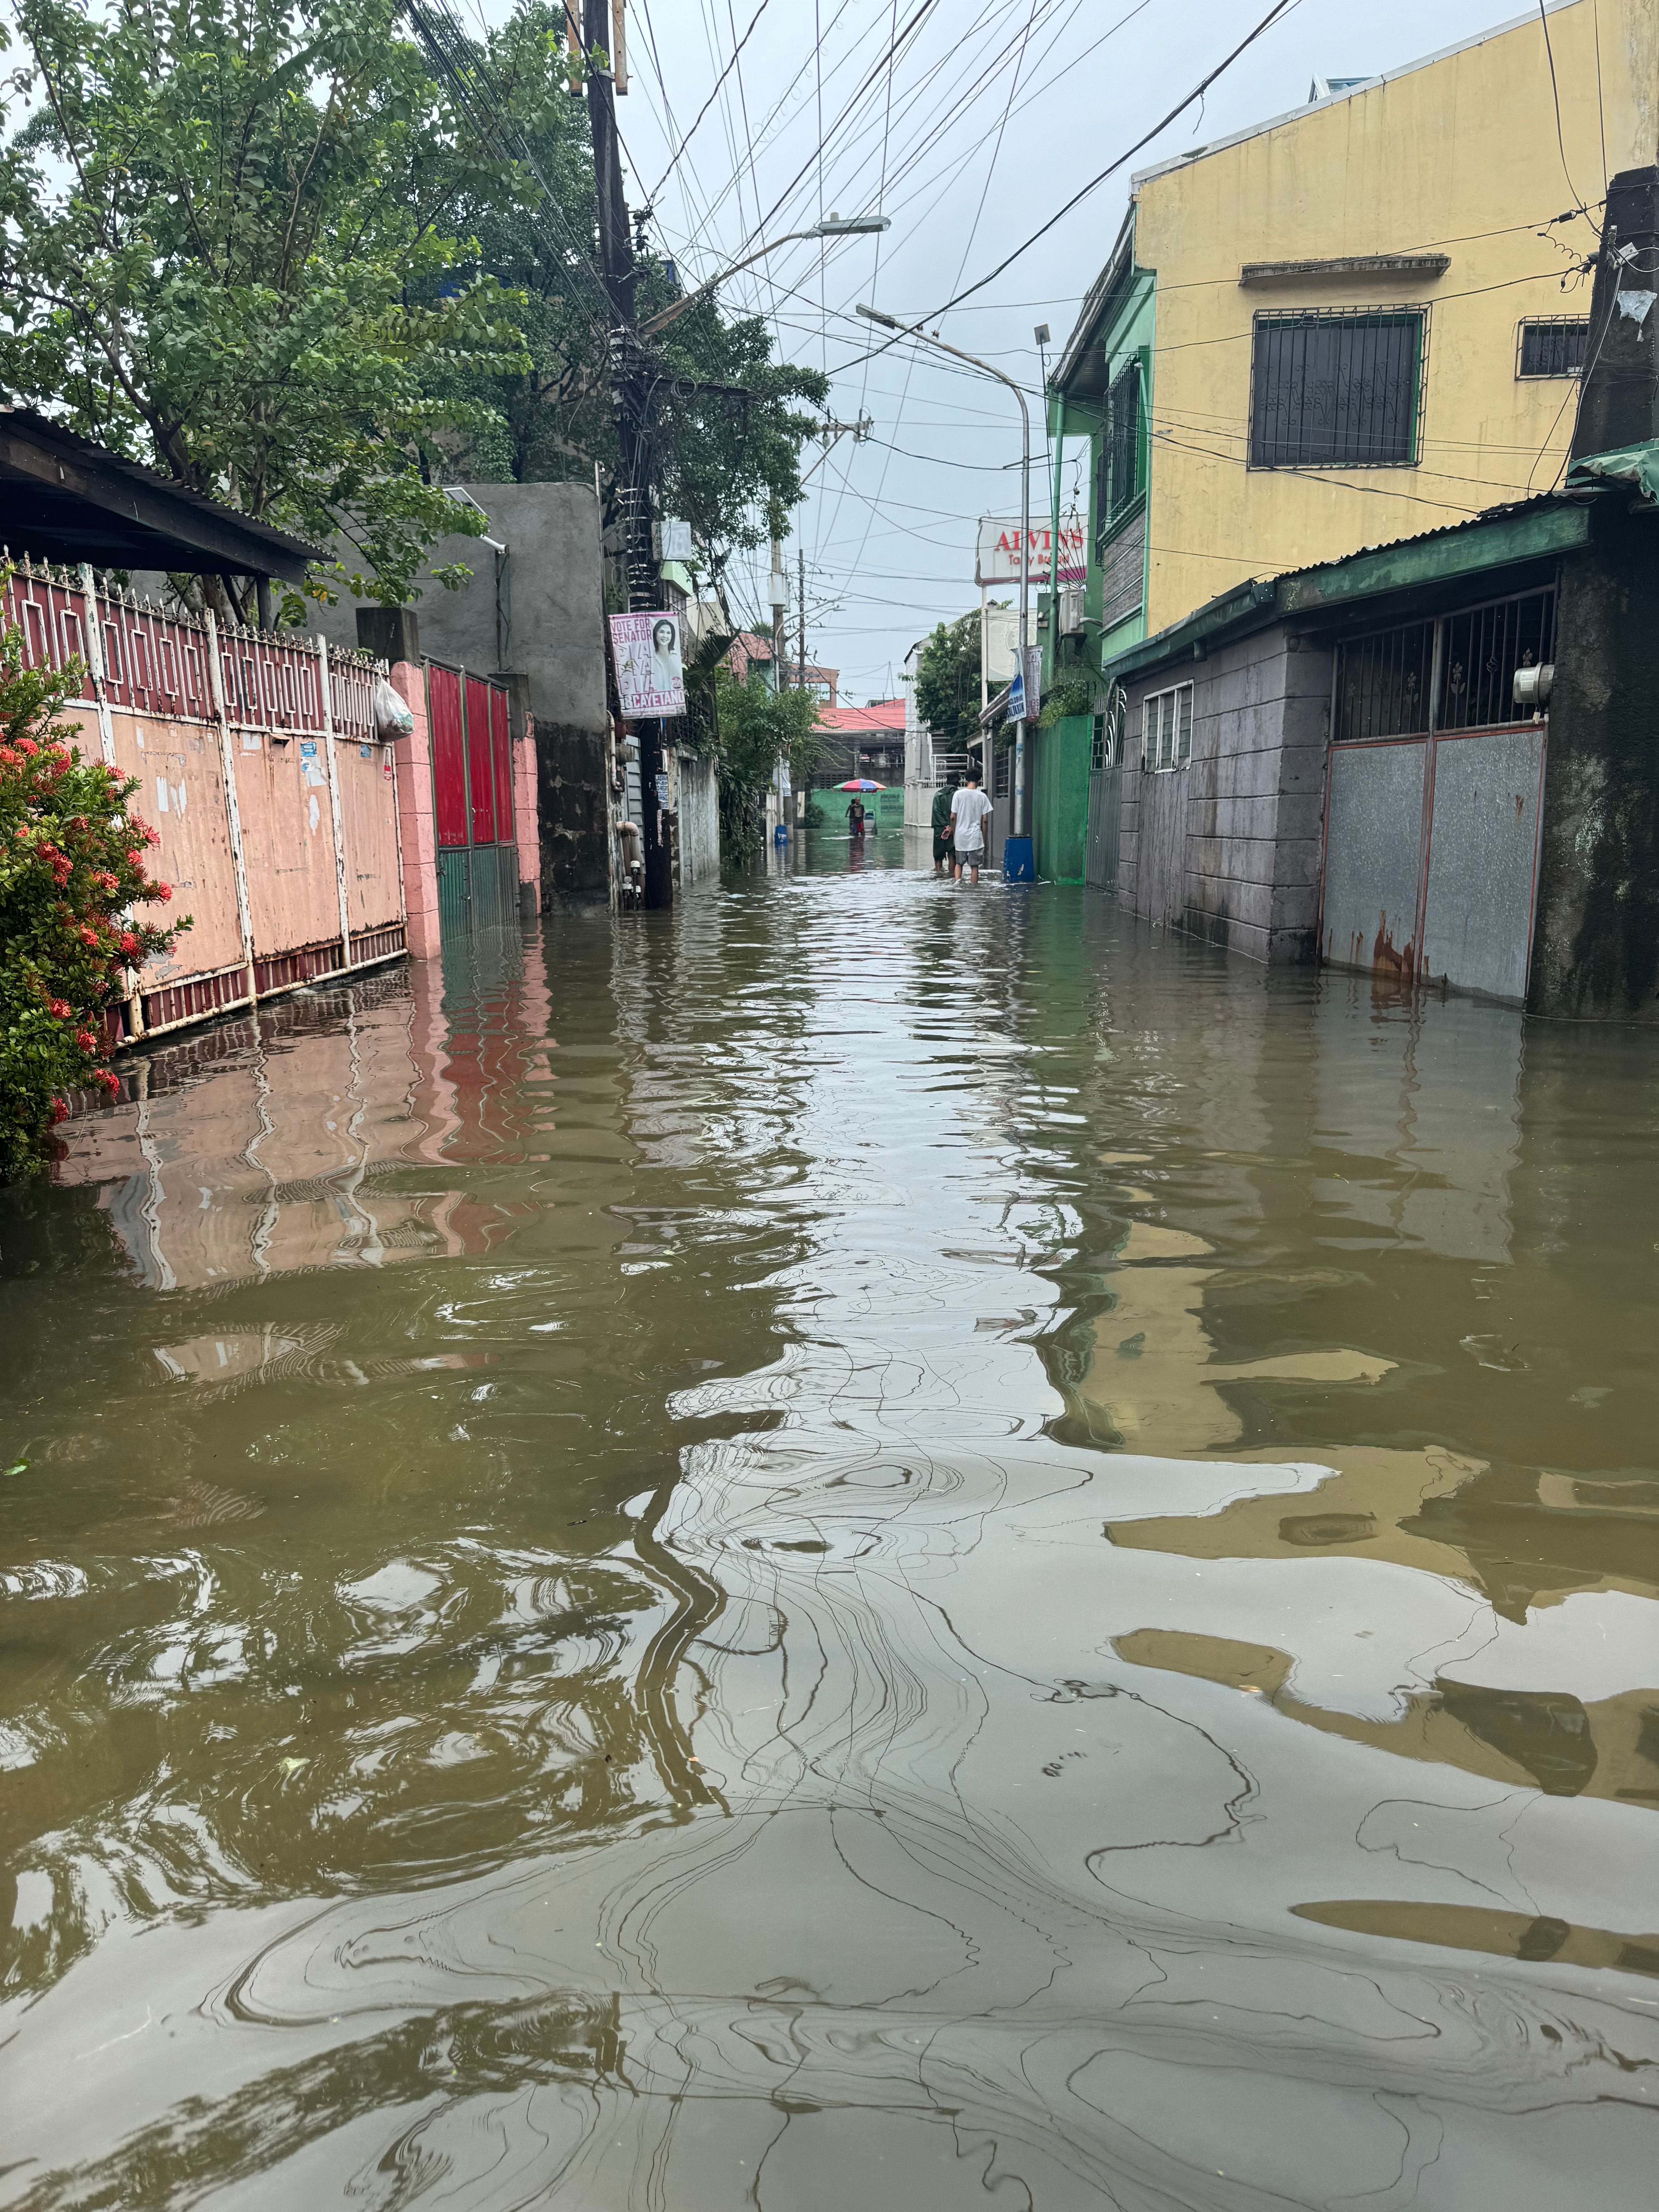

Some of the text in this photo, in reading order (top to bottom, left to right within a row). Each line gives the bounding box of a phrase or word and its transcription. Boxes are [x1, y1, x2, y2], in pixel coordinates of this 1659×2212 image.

[611, 618, 651, 633] VOTE FOR
[612, 629, 653, 644] SENATOR
[613, 643, 652, 662] PIA
[620, 675, 658, 694] PIA
[634, 690, 685, 708] CAYETANO
